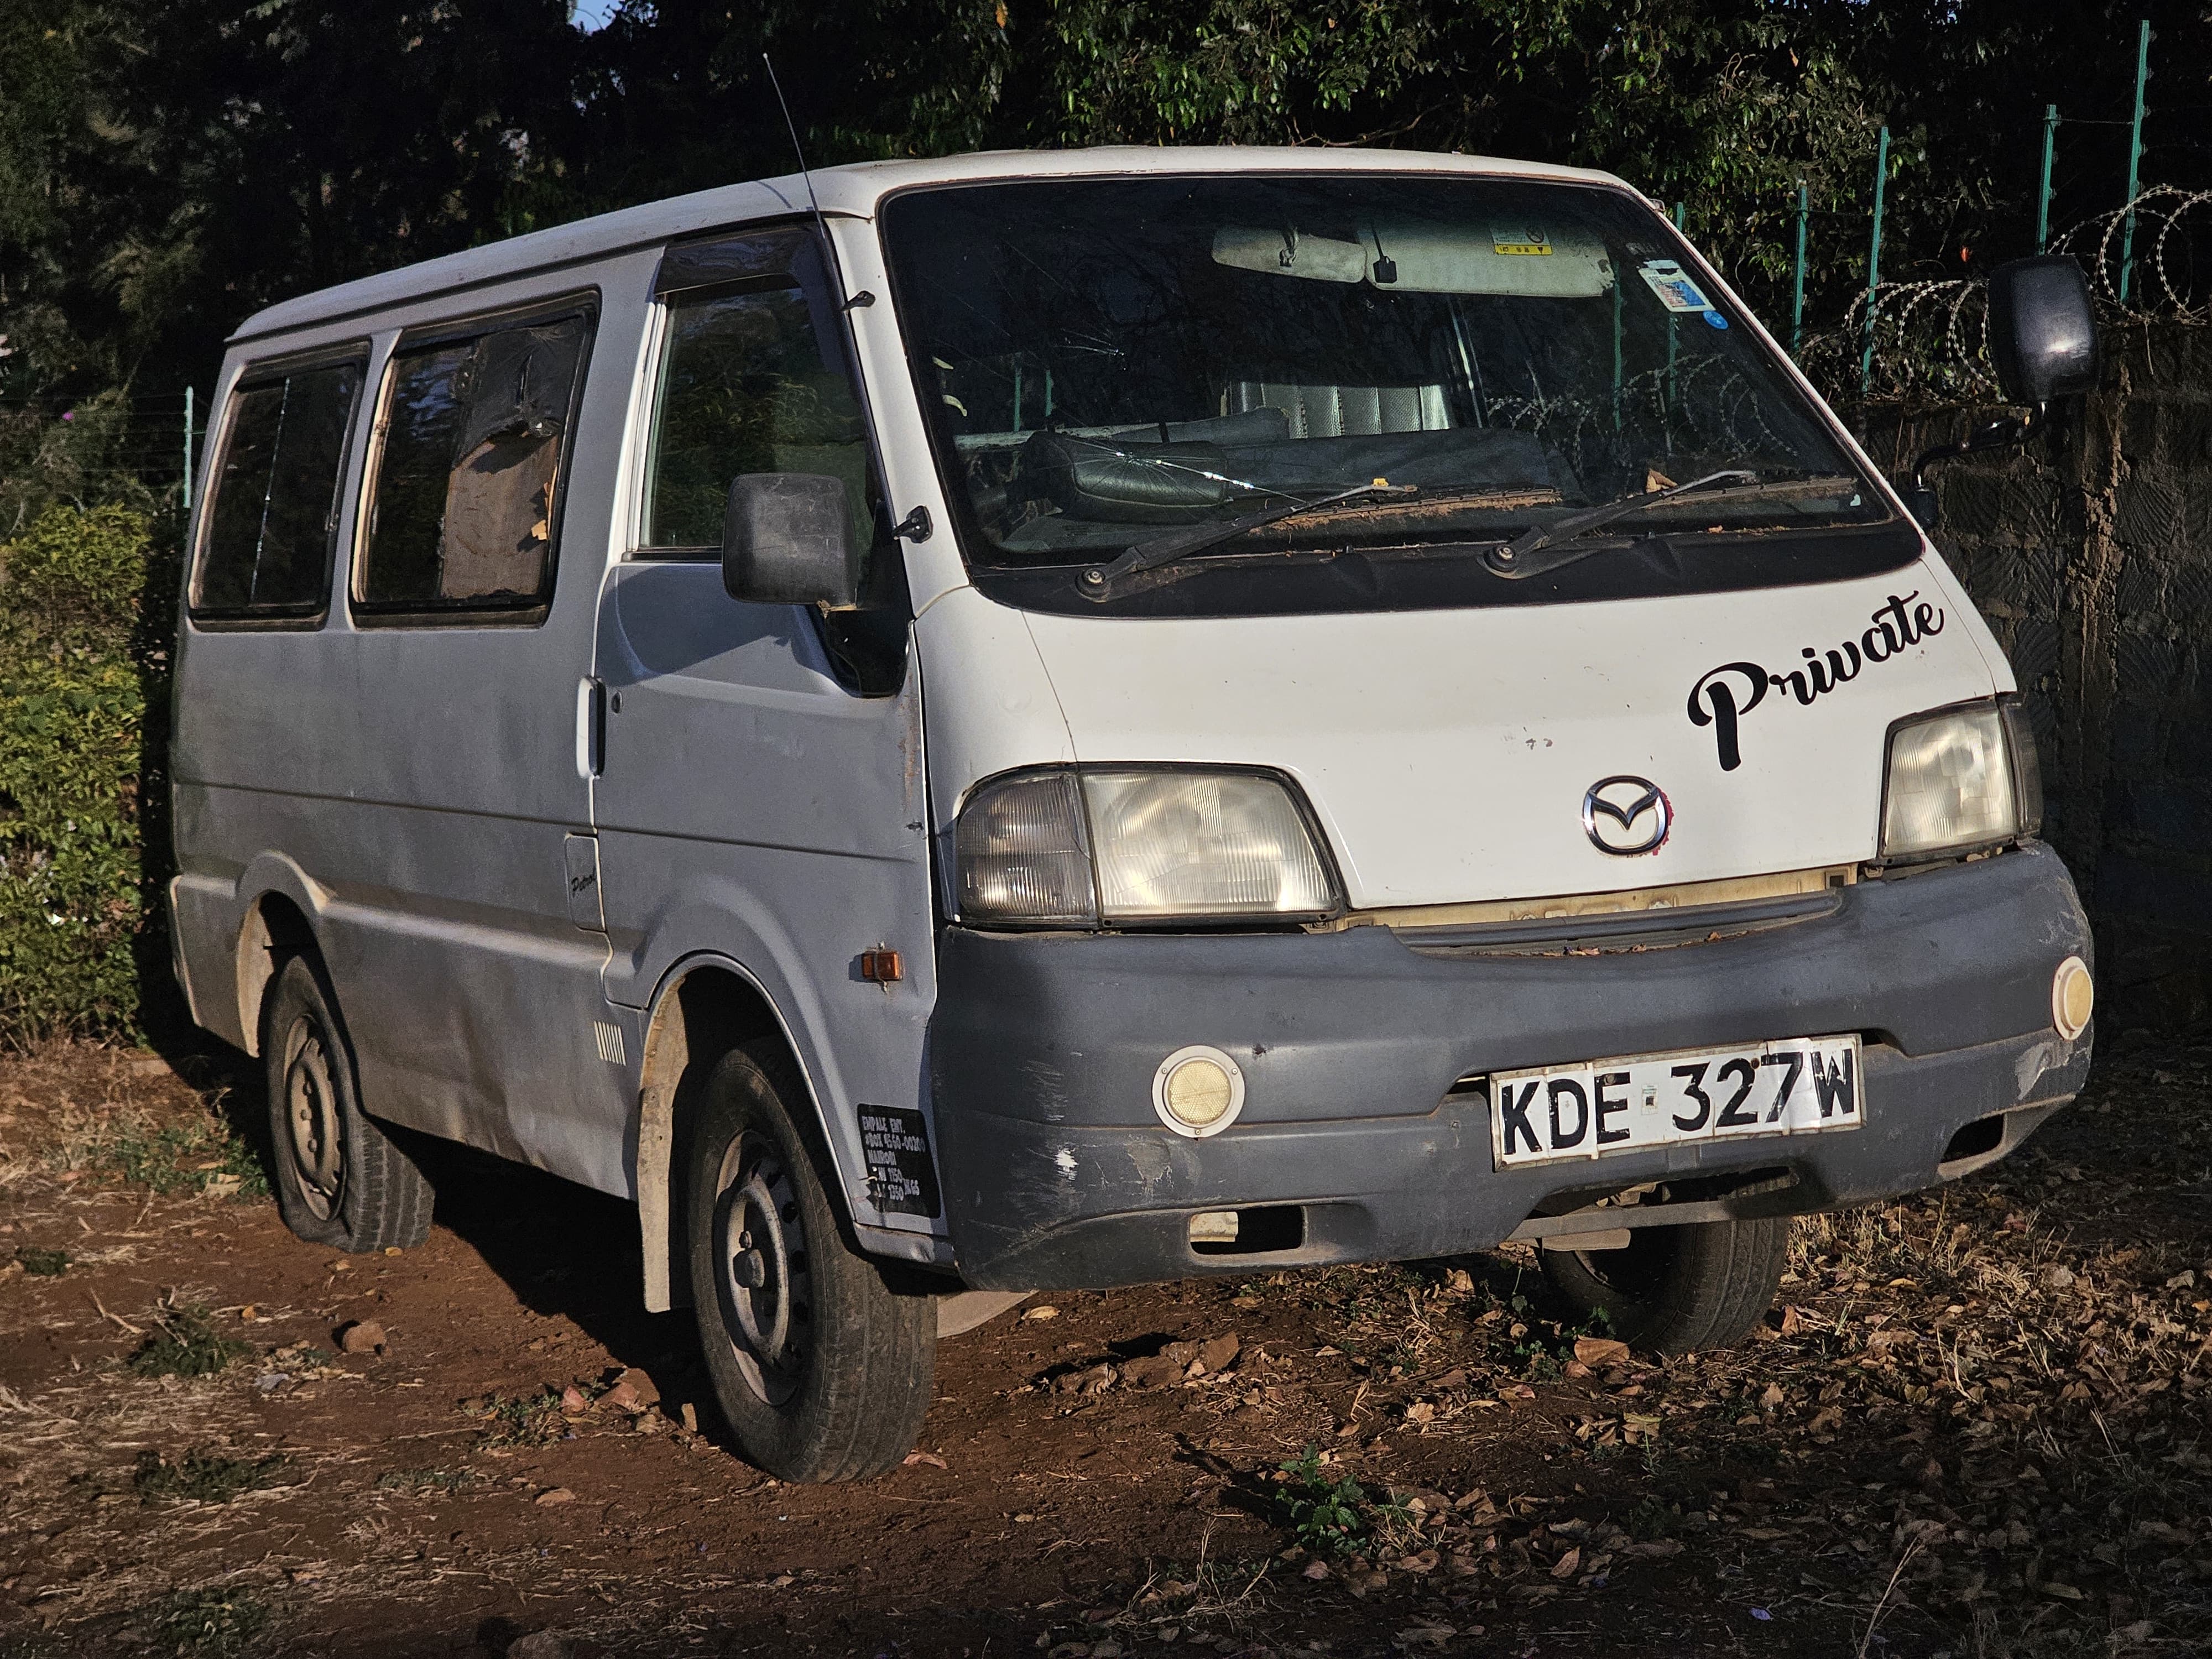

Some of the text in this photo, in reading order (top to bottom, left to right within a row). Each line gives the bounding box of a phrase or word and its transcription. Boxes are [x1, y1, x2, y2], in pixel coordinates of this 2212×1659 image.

[1687, 590, 1945, 771] Private
[1501, 1048, 1854, 1155] KDE 327W
